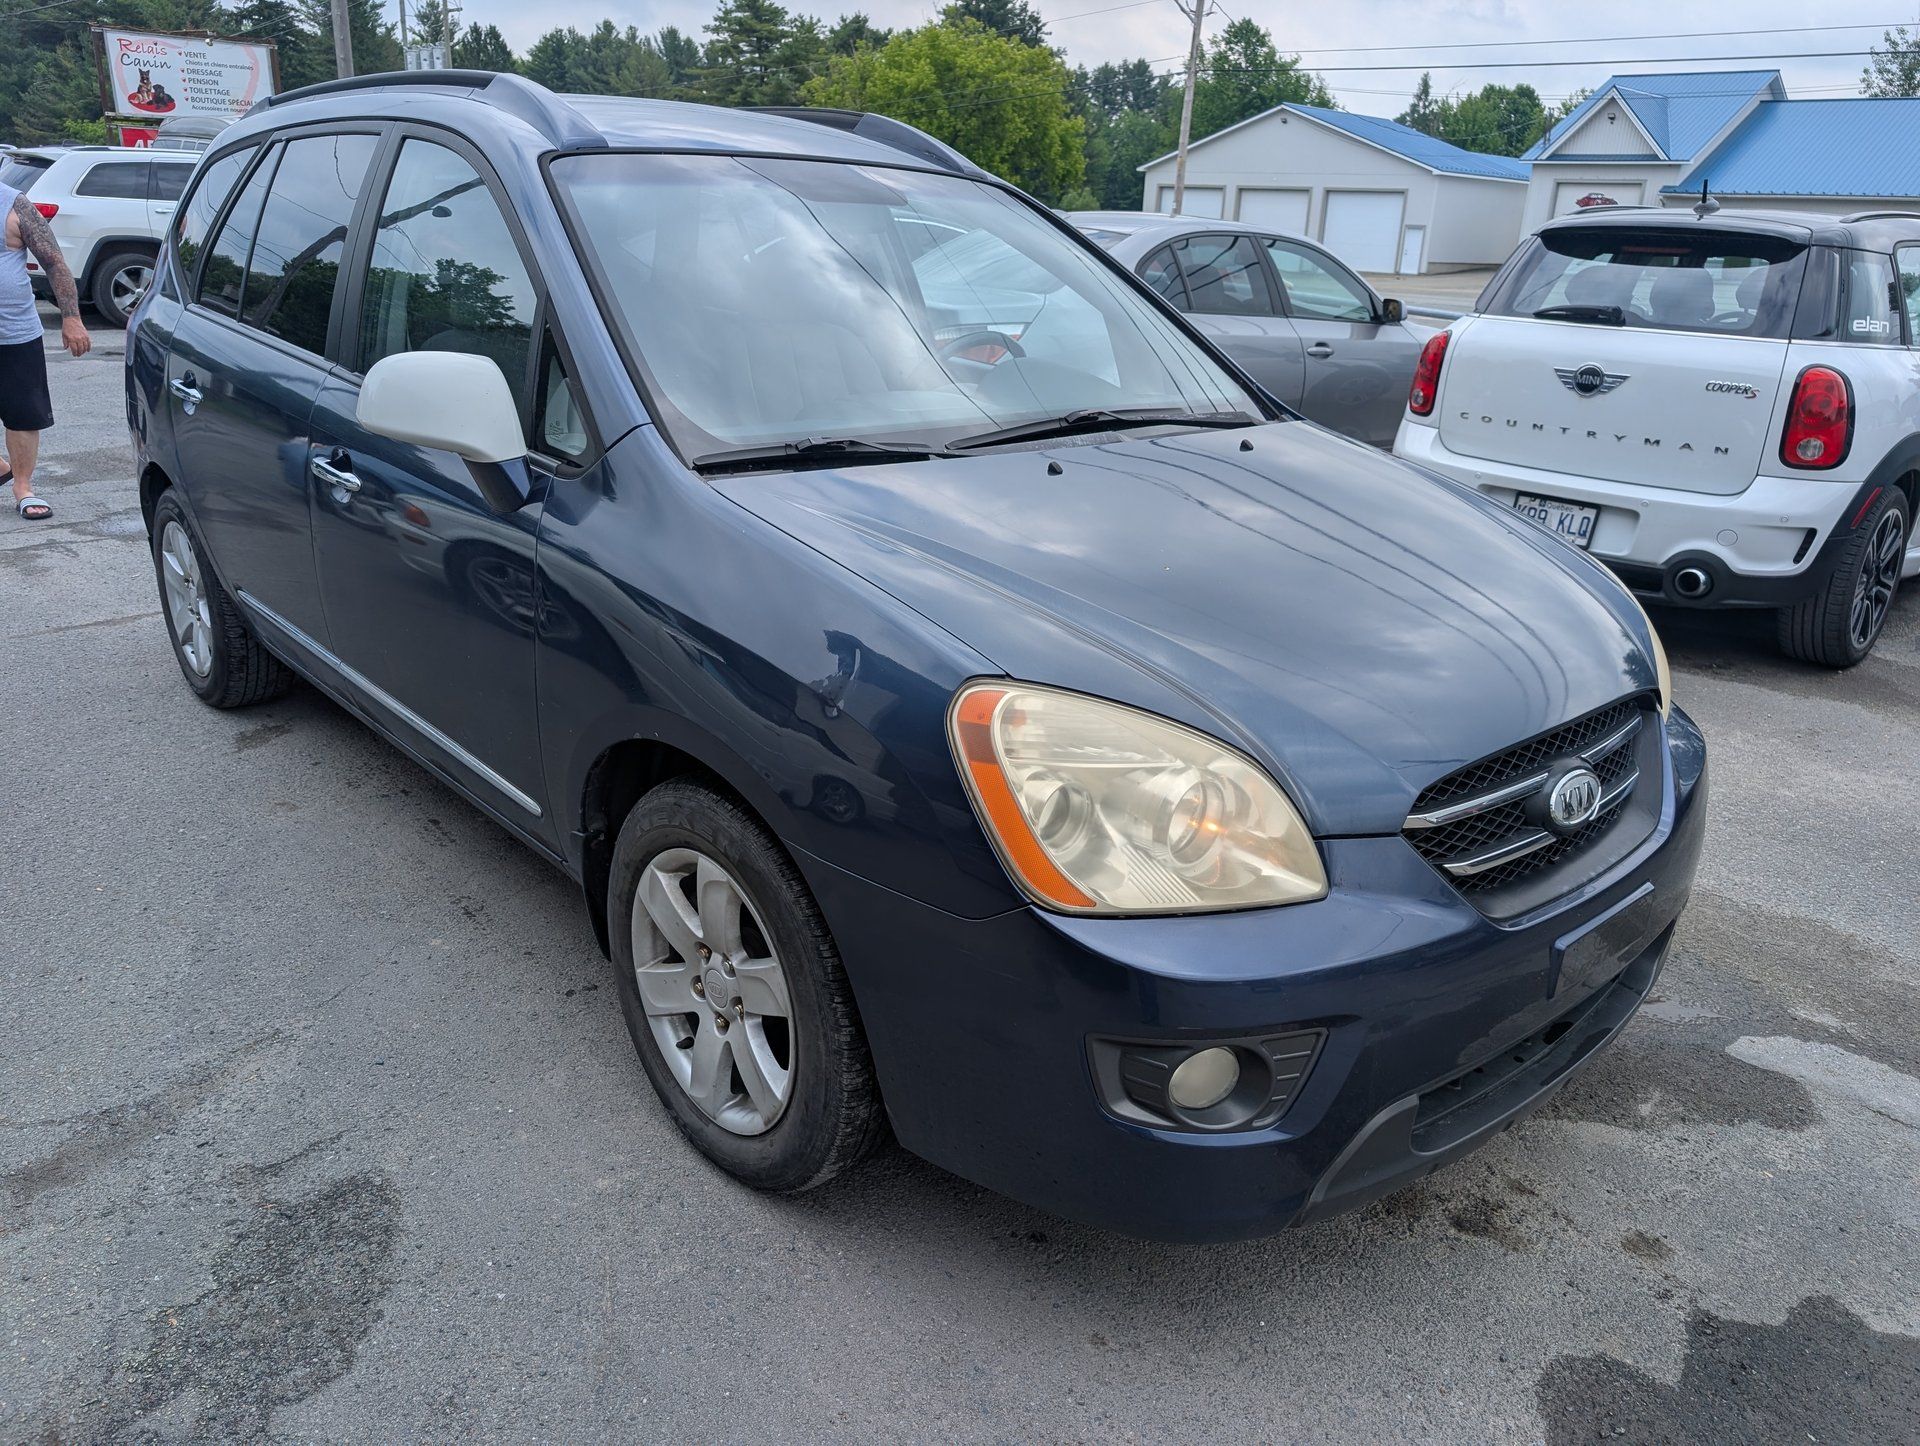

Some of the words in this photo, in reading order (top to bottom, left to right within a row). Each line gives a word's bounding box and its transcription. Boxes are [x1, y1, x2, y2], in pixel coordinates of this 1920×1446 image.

[117, 38, 167, 55] Relais
[121, 53, 171, 69] Canin
[184, 51, 207, 59] VENTE
[186, 68, 223, 77] DRESSAGE
[188, 77, 219, 86] PENSION
[189, 87, 231, 96] TOILETTAGE
[190, 96, 226, 106] BOUTIQUE
[1853, 315, 1890, 334] elan
[1576, 374, 1600, 386] MINI
[1705, 380, 1752, 396] COOPER
[1459, 411, 1729, 456] COUNTRYMAN
[1556, 511, 1592, 538] KLQ
[1558, 779, 1596, 820] KIA
